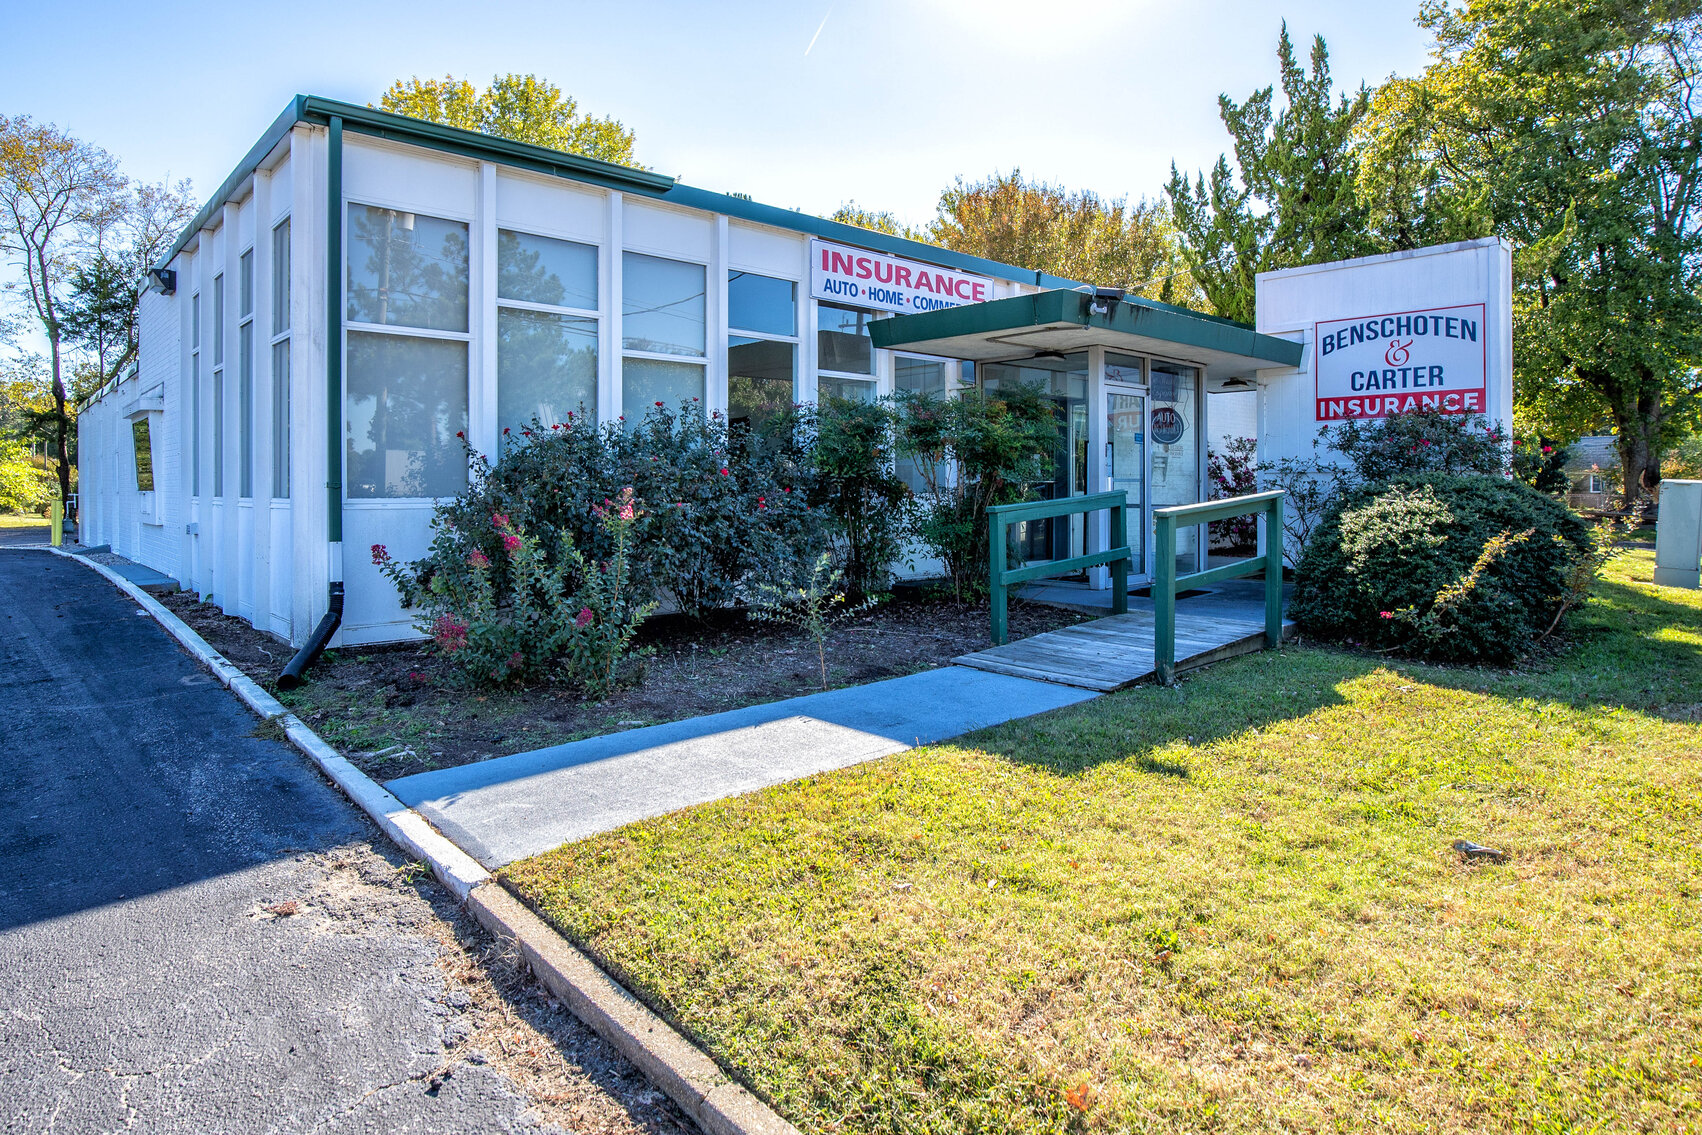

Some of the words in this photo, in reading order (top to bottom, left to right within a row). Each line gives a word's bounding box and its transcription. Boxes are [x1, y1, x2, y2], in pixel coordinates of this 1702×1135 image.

[821, 249, 986, 302] INSURANCE
[823, 278, 859, 297] AUTO
[868, 286, 904, 305] HOME
[1322, 315, 1477, 356] BENSCHOTEN
[1384, 339, 1414, 367] &
[1350, 365, 1444, 391] CARTER
[1156, 412, 1176, 424] AUTO
[1319, 392, 1479, 418] INSURANCE
